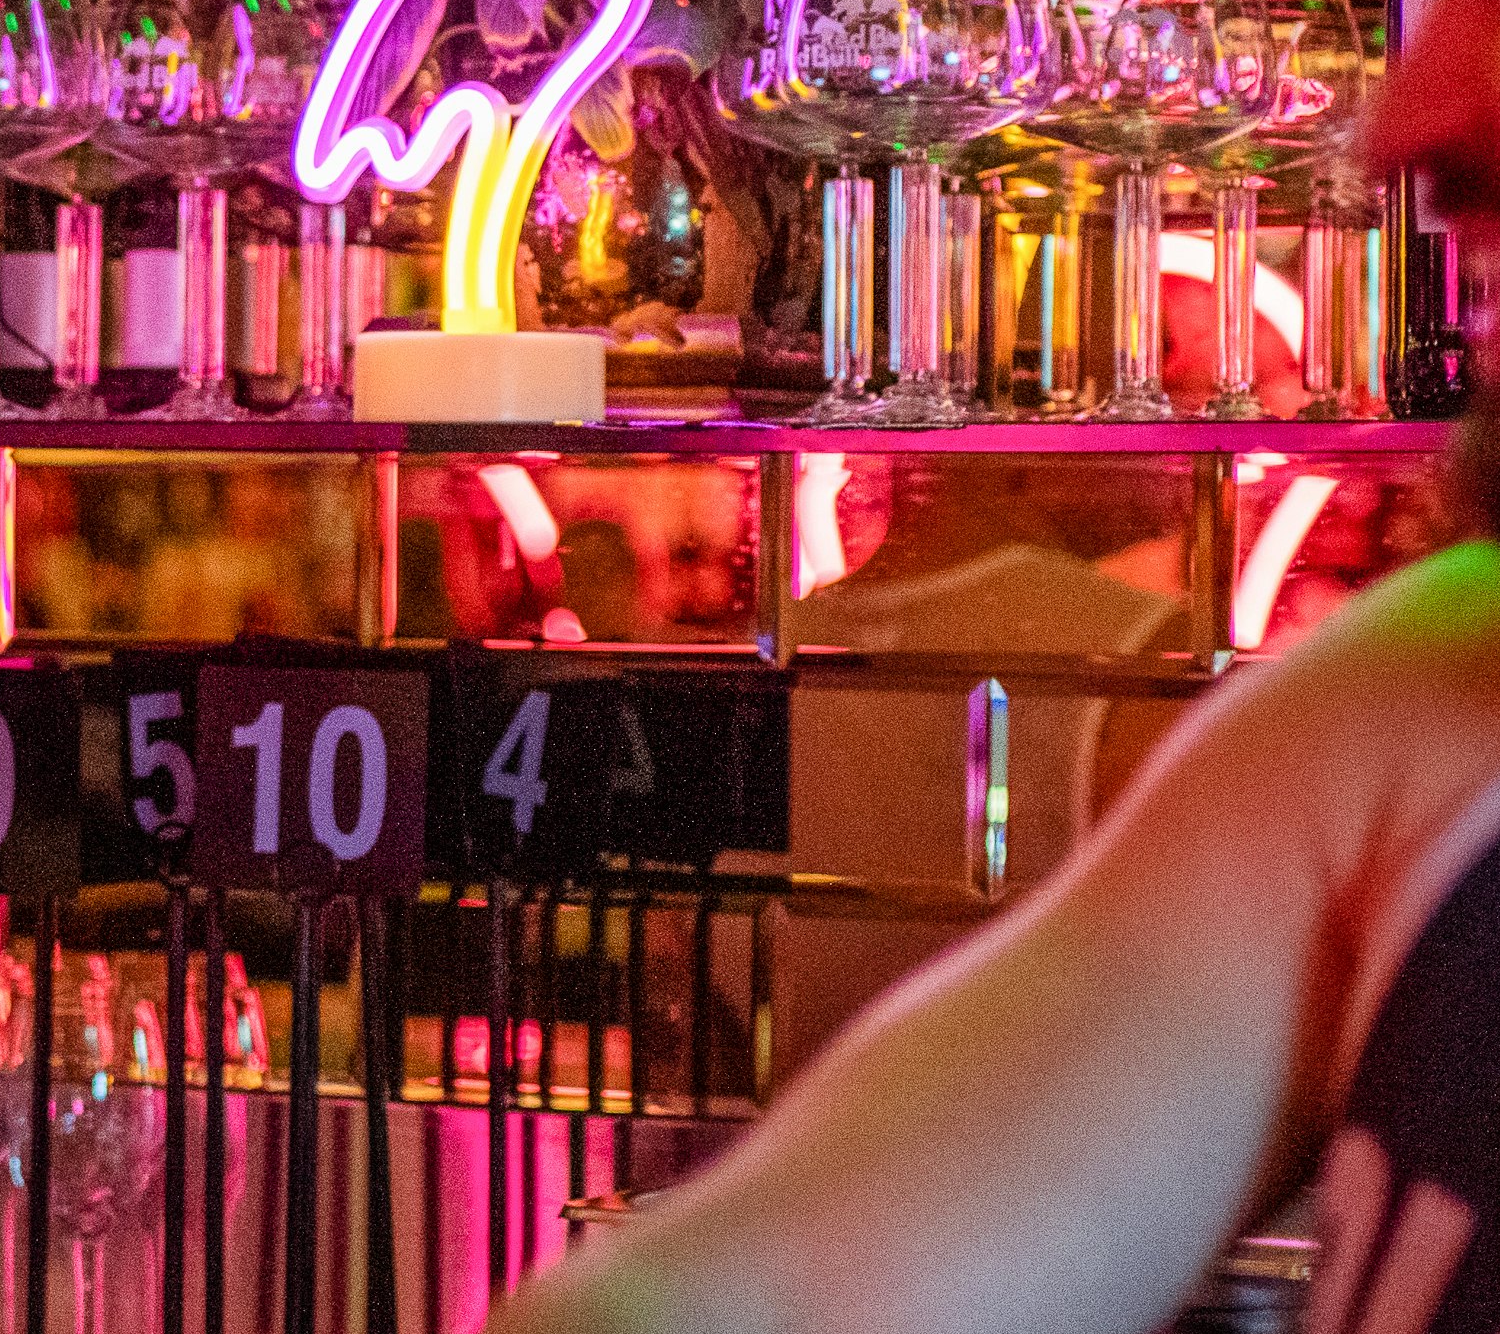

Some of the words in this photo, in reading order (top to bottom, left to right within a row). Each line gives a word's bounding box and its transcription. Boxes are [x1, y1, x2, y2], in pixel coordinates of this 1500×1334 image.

[760, 44, 810, 73] Rd
[128, 690, 198, 838] 5
[232, 702, 388, 860] 10
[482, 690, 551, 835] 4
